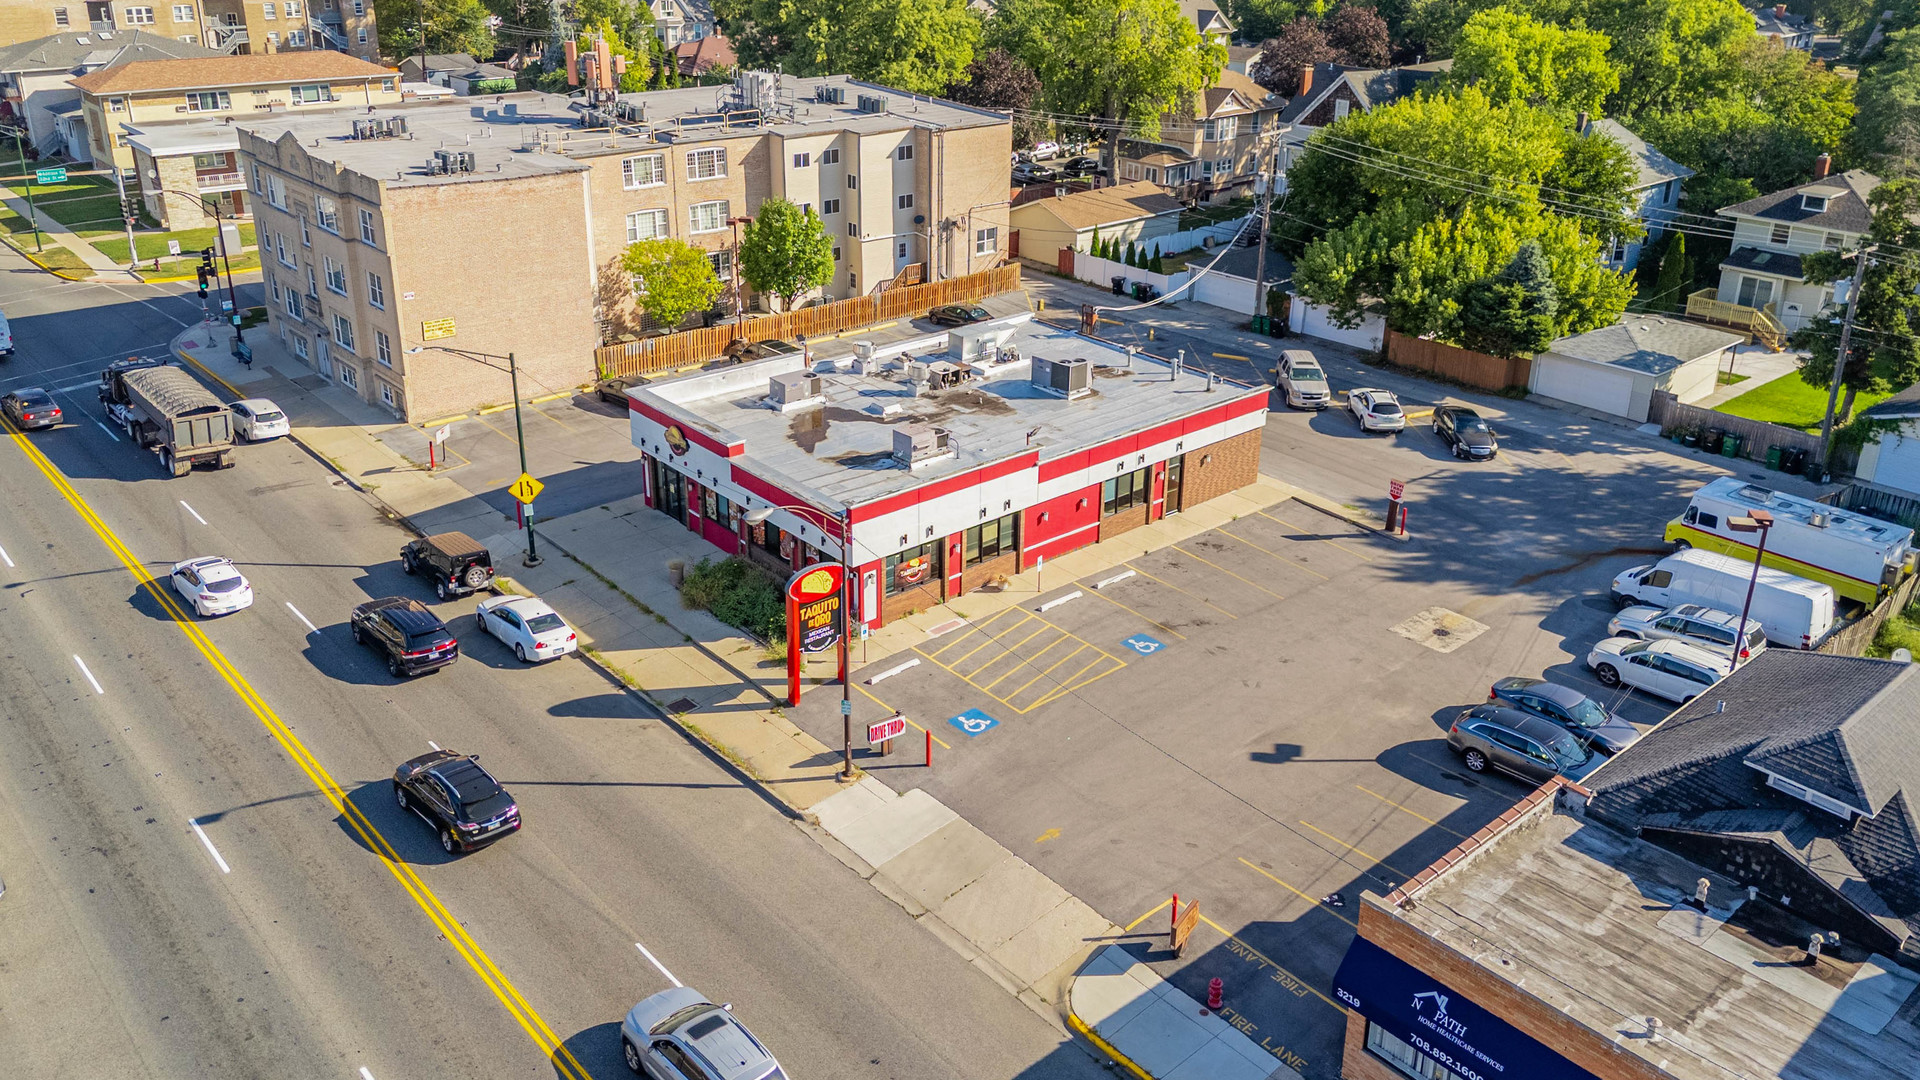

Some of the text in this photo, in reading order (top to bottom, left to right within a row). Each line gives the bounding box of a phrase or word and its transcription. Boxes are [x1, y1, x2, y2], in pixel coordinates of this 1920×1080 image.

[1390, 480, 1404, 488] DRIVE
[800, 597, 839, 621] TAQUITO
[808, 611, 832, 628] DE ORO
[804, 629, 835, 644] RESTAURANT
[808, 625, 831, 638] MEXICAN
[870, 719, 902, 742] DRIVE THRU
[1225, 940, 1309, 998] FIRE LANE
[1336, 987, 1361, 1008] 3219
[1433, 1010, 1467, 1037] PATH
[1219, 1007, 1309, 1071] FIRE LANE
[1417, 1015, 1505, 1072] HOME HEALTHCARE SERVICES
